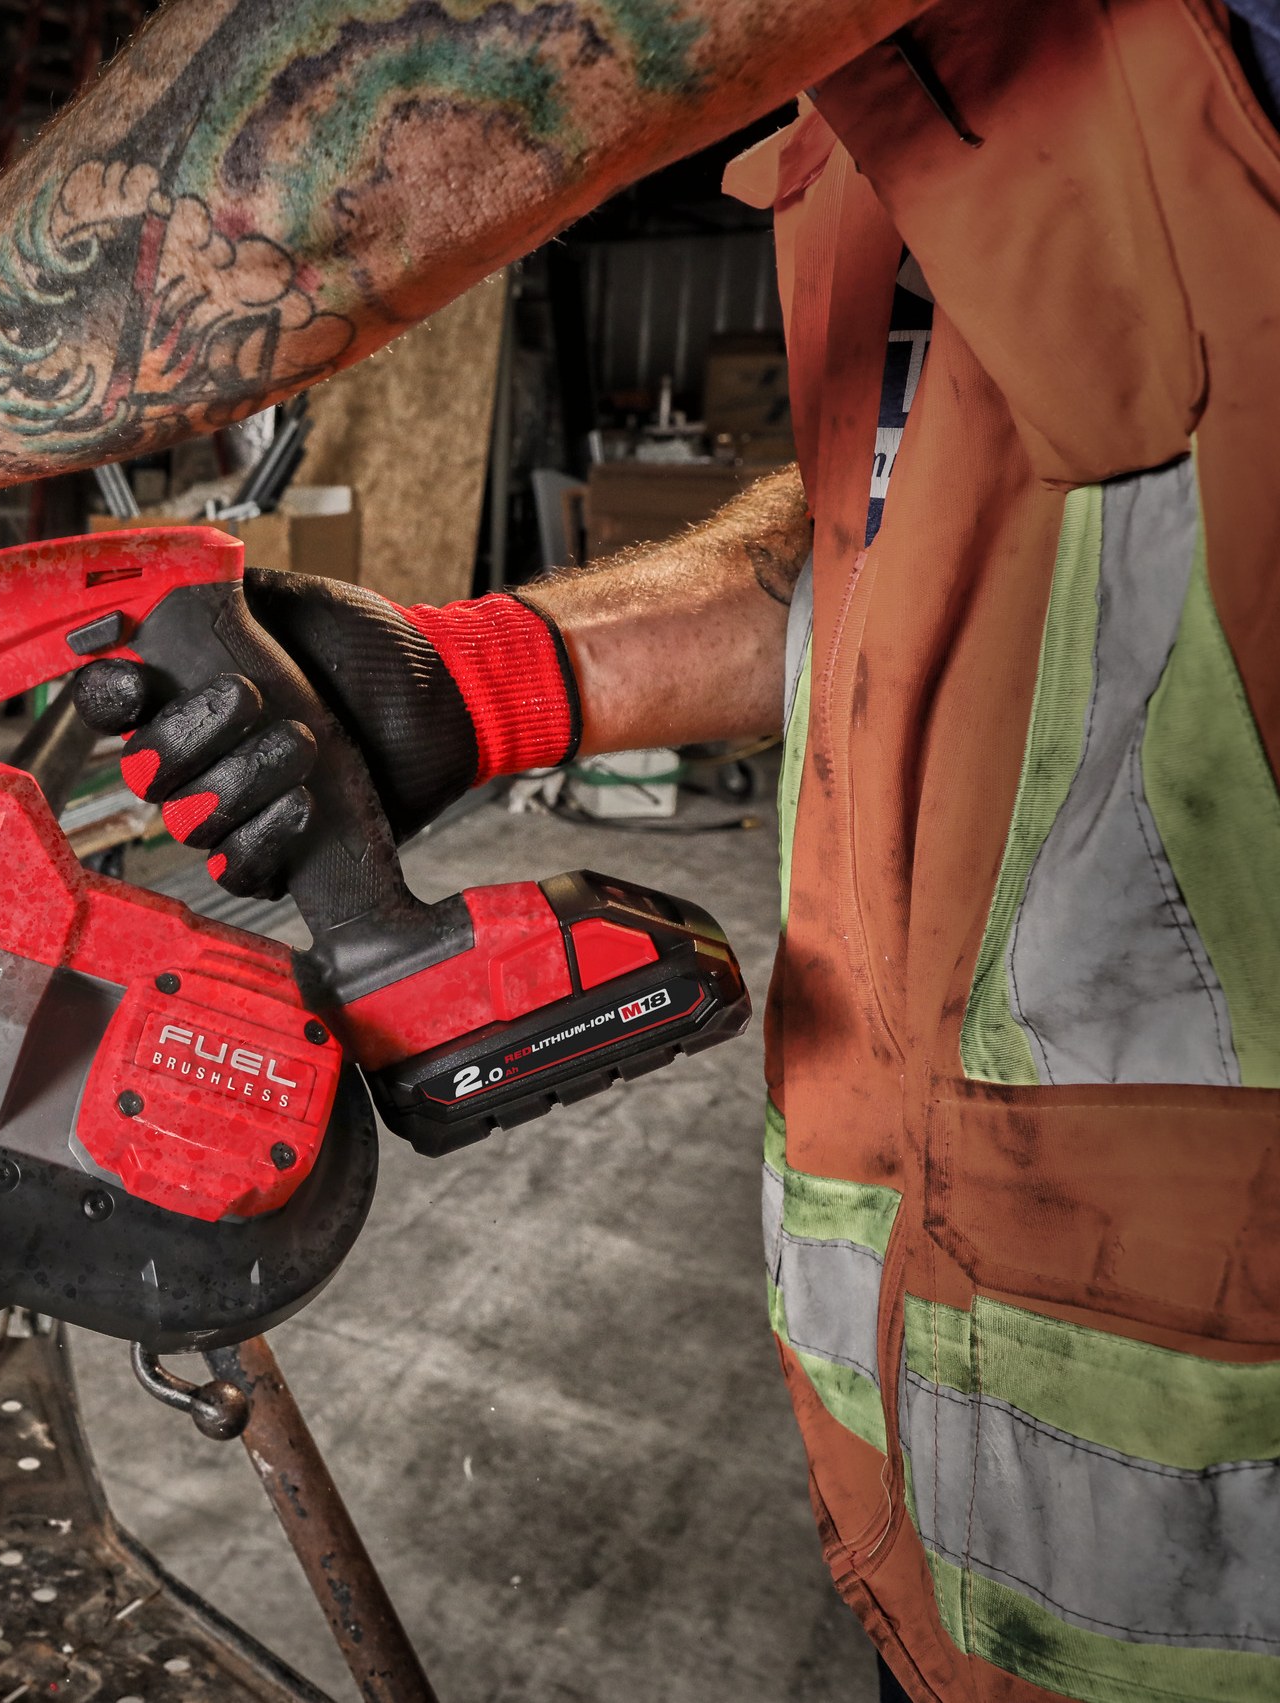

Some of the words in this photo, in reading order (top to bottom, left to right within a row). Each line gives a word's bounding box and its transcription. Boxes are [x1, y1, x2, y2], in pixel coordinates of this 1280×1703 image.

[158, 1024, 298, 1089] FUEL
[504, 1010, 616, 1064] REDLITHIUM-ION
[621, 990, 668, 1021] M18
[152, 1051, 289, 1108] BRUSHLESS
[452, 1064, 504, 1099] 2.0
[505, 1065, 519, 1077] Ah
